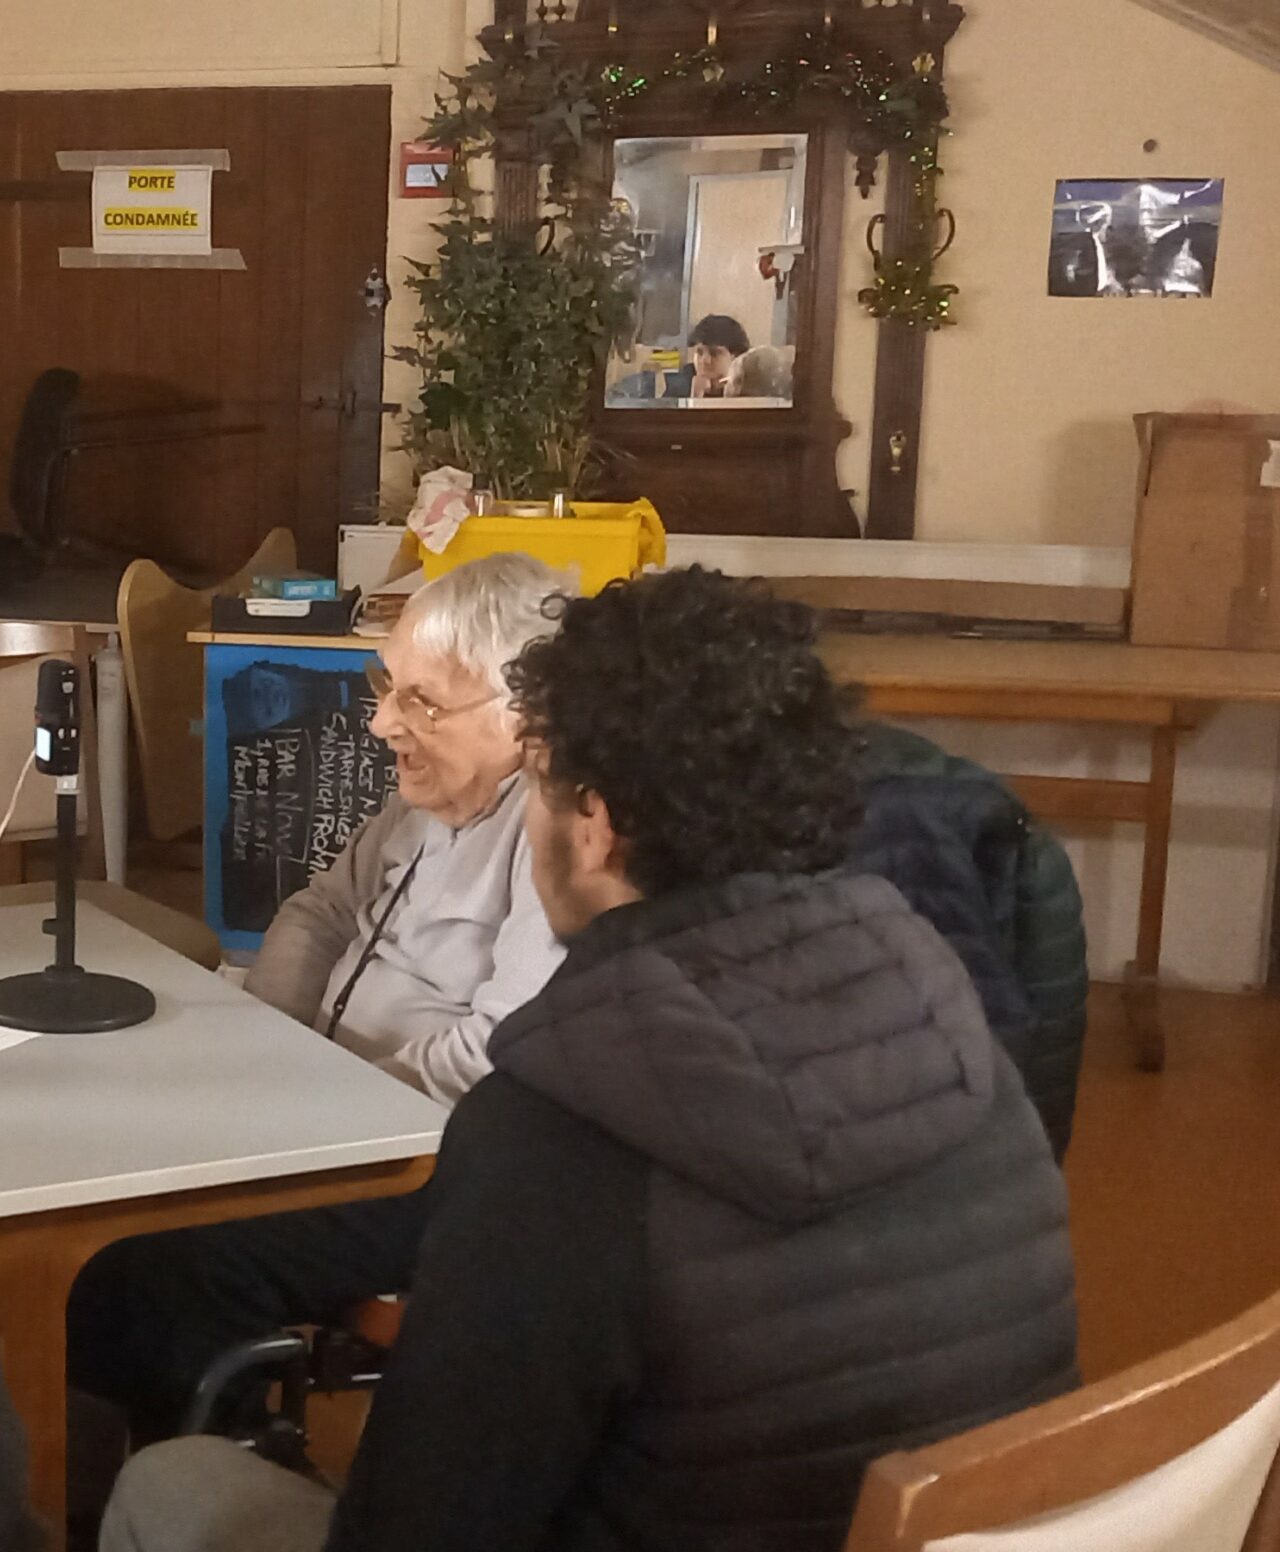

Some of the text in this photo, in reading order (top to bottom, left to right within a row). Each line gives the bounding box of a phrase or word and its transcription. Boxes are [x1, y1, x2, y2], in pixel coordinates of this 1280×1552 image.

[128, 175, 175, 189] PORTE
[104, 210, 198, 227] CONDAMNÉE
[275, 738, 301, 778] BAR
[314, 711, 348, 808] SANDWICH
